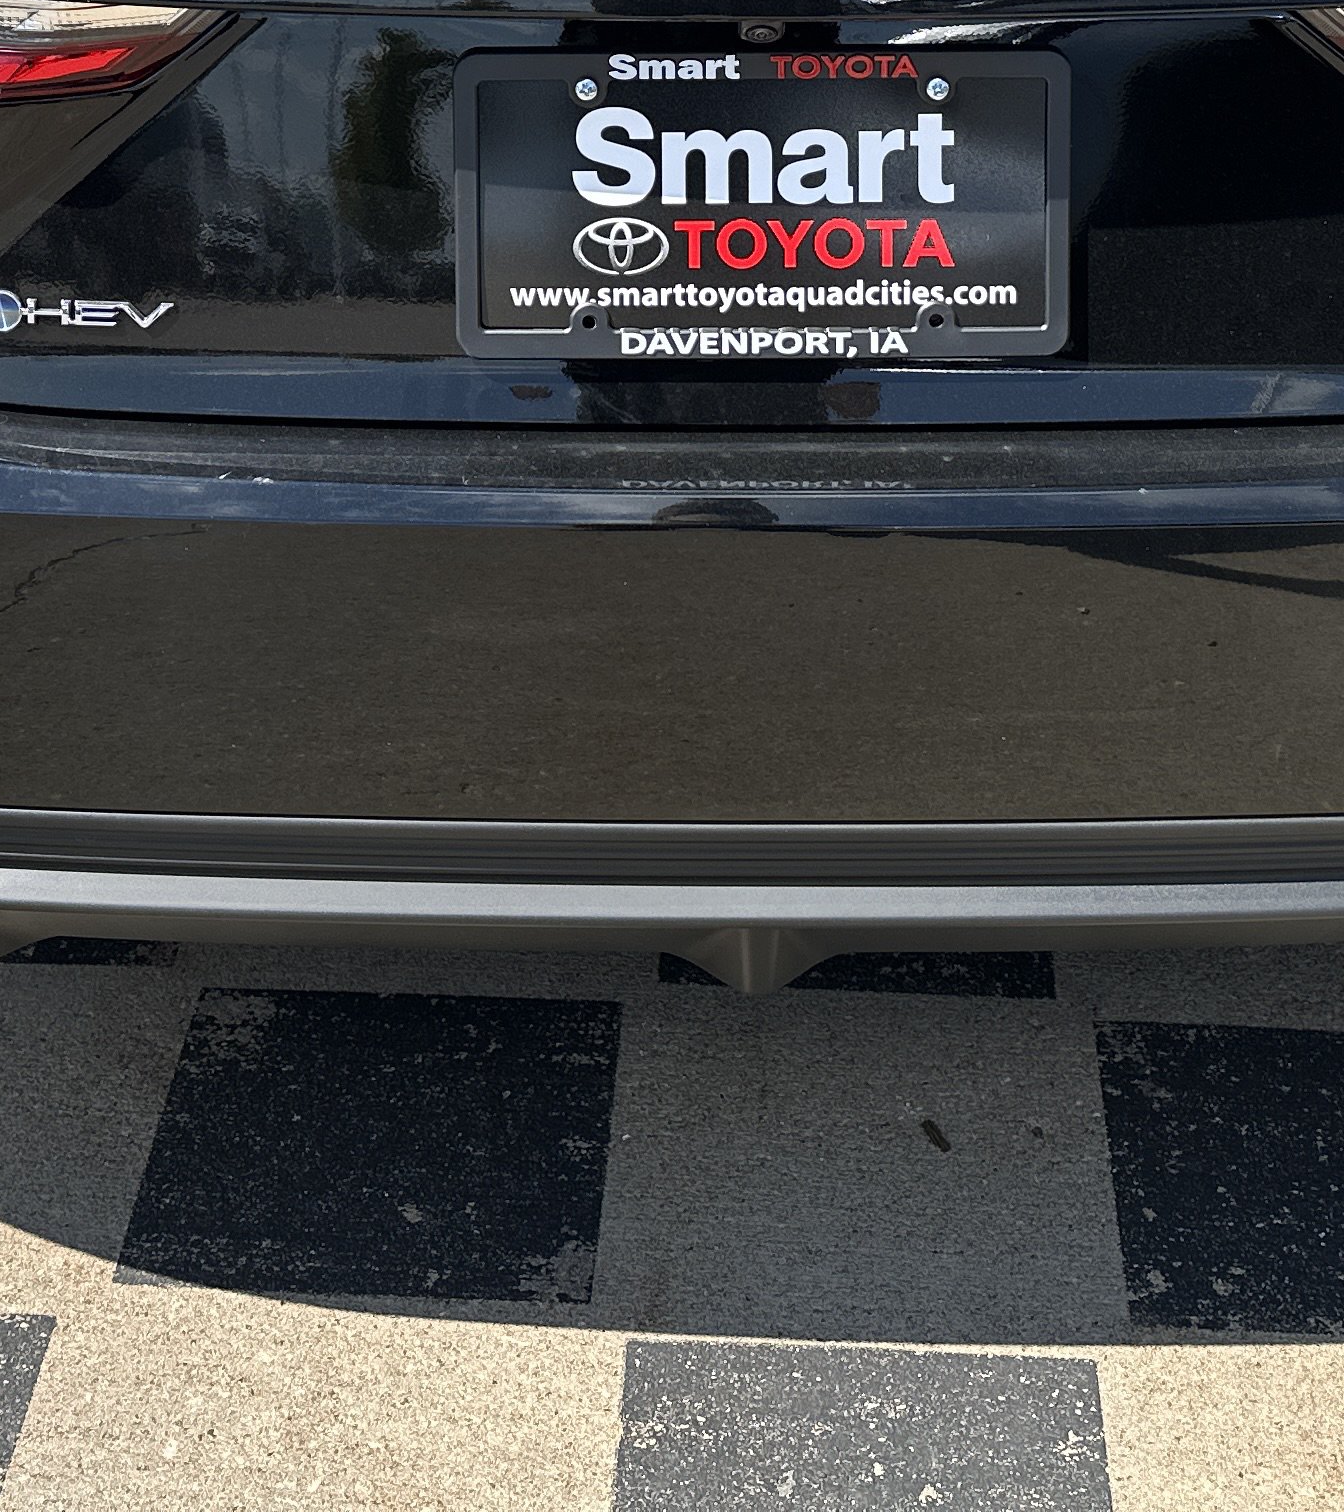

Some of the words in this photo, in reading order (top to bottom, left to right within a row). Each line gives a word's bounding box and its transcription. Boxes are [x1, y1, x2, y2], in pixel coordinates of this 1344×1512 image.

[608, 53, 741, 80] Smart
[769, 54, 920, 80] TOYOTA
[571, 105, 956, 208] Smart
[673, 217, 955, 270] TOYOTA
[509, 279, 1018, 313] www.smarttoyotaquadcities.com
[620, 330, 858, 358] DAVENPORT,
[868, 330, 909, 355] IA
